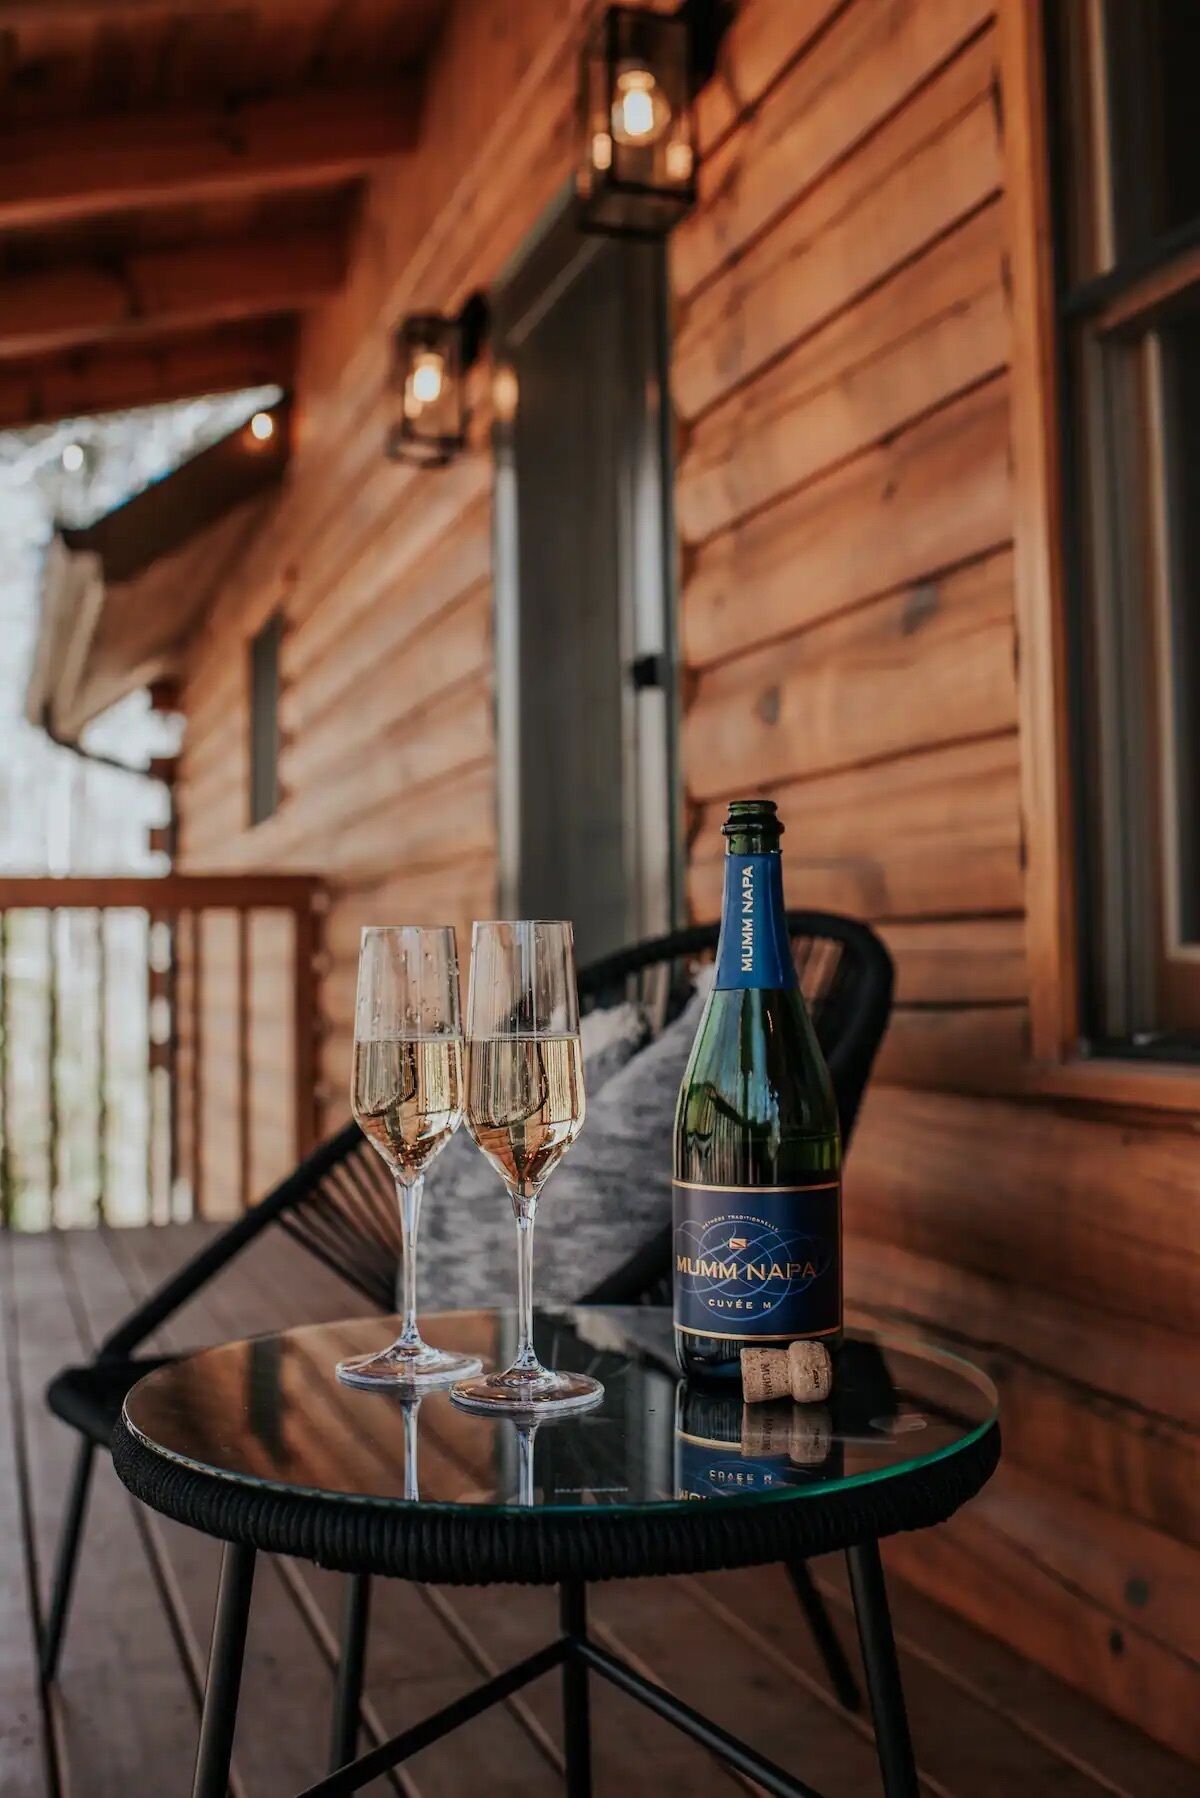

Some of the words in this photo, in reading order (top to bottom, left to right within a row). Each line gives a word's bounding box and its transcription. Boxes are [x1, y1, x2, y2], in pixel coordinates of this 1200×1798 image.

[741, 865, 754, 913] NAPA
[741, 918, 754, 972] MUMM
[676, 1255, 738, 1280] MUMM
[747, 1261, 818, 1282] NAPA
[708, 1298, 754, 1310] CUVÉE
[762, 1301, 773, 1310] M
